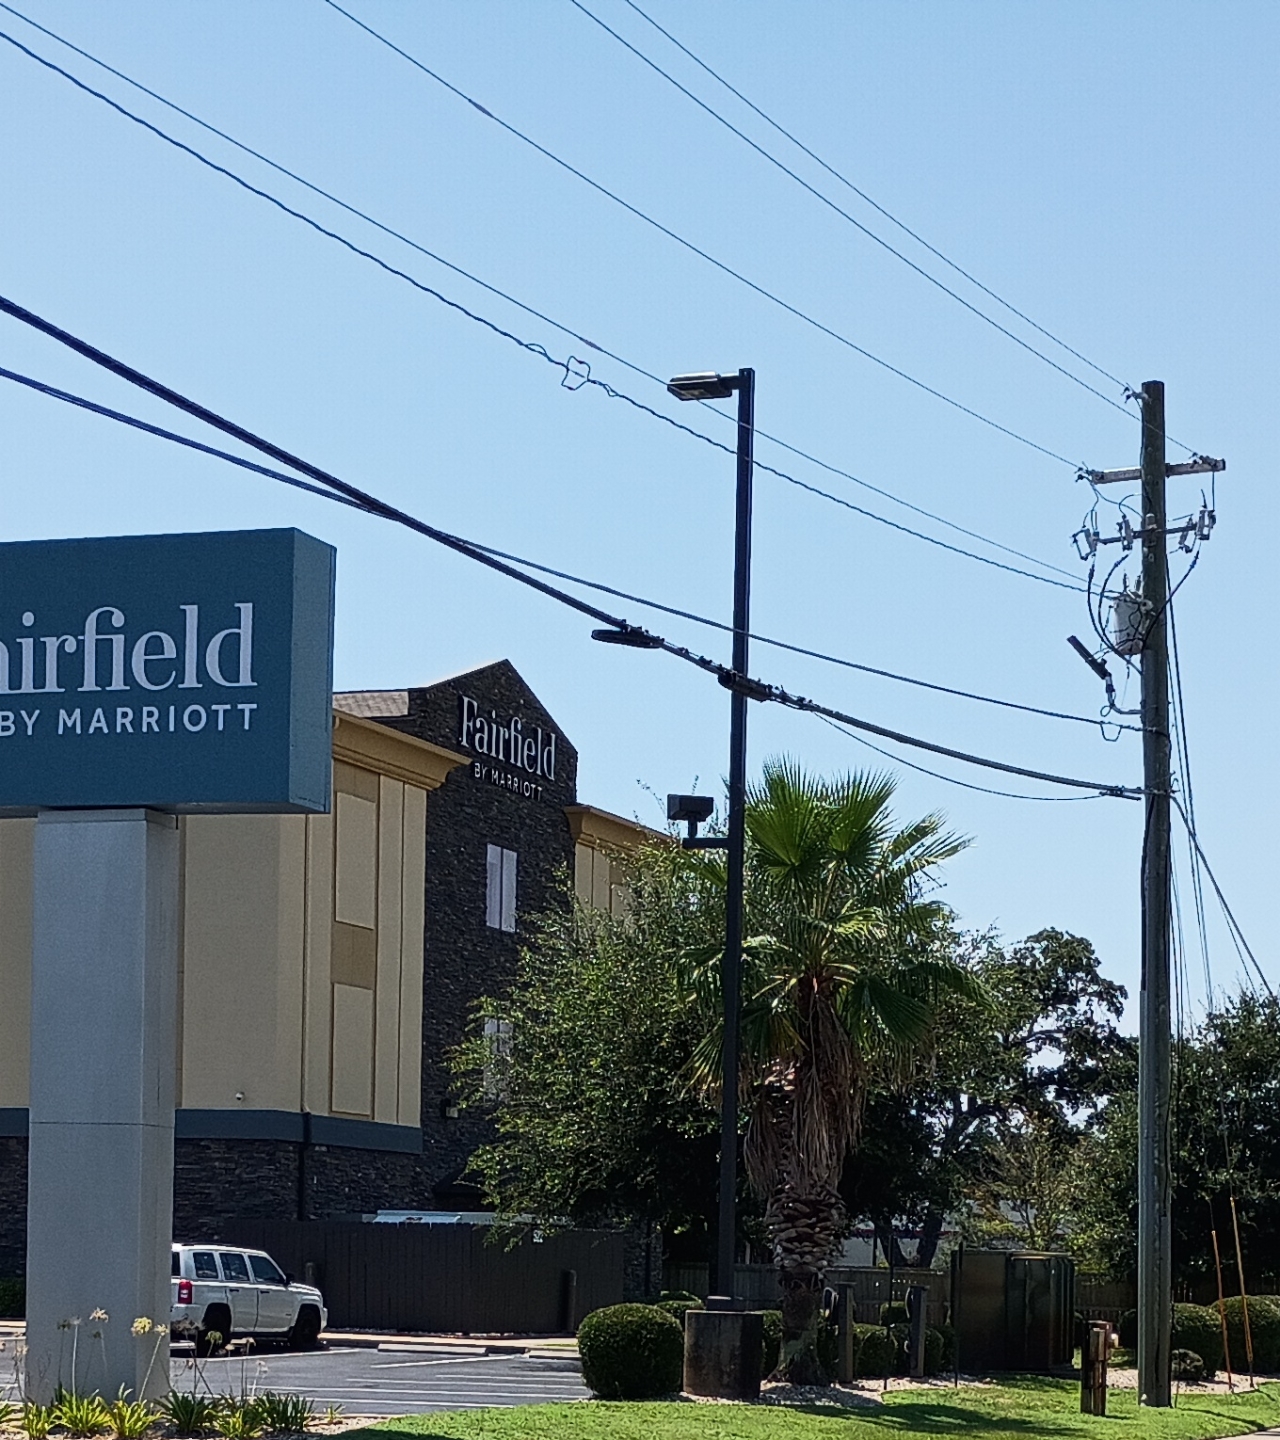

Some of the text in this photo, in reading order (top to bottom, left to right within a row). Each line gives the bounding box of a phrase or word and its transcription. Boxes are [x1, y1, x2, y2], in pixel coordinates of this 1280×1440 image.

[57, 703, 258, 736] MARRIOTT
[460, 695, 556, 781] Fairfield
[474, 762, 543, 801] BY MARRIOTT
